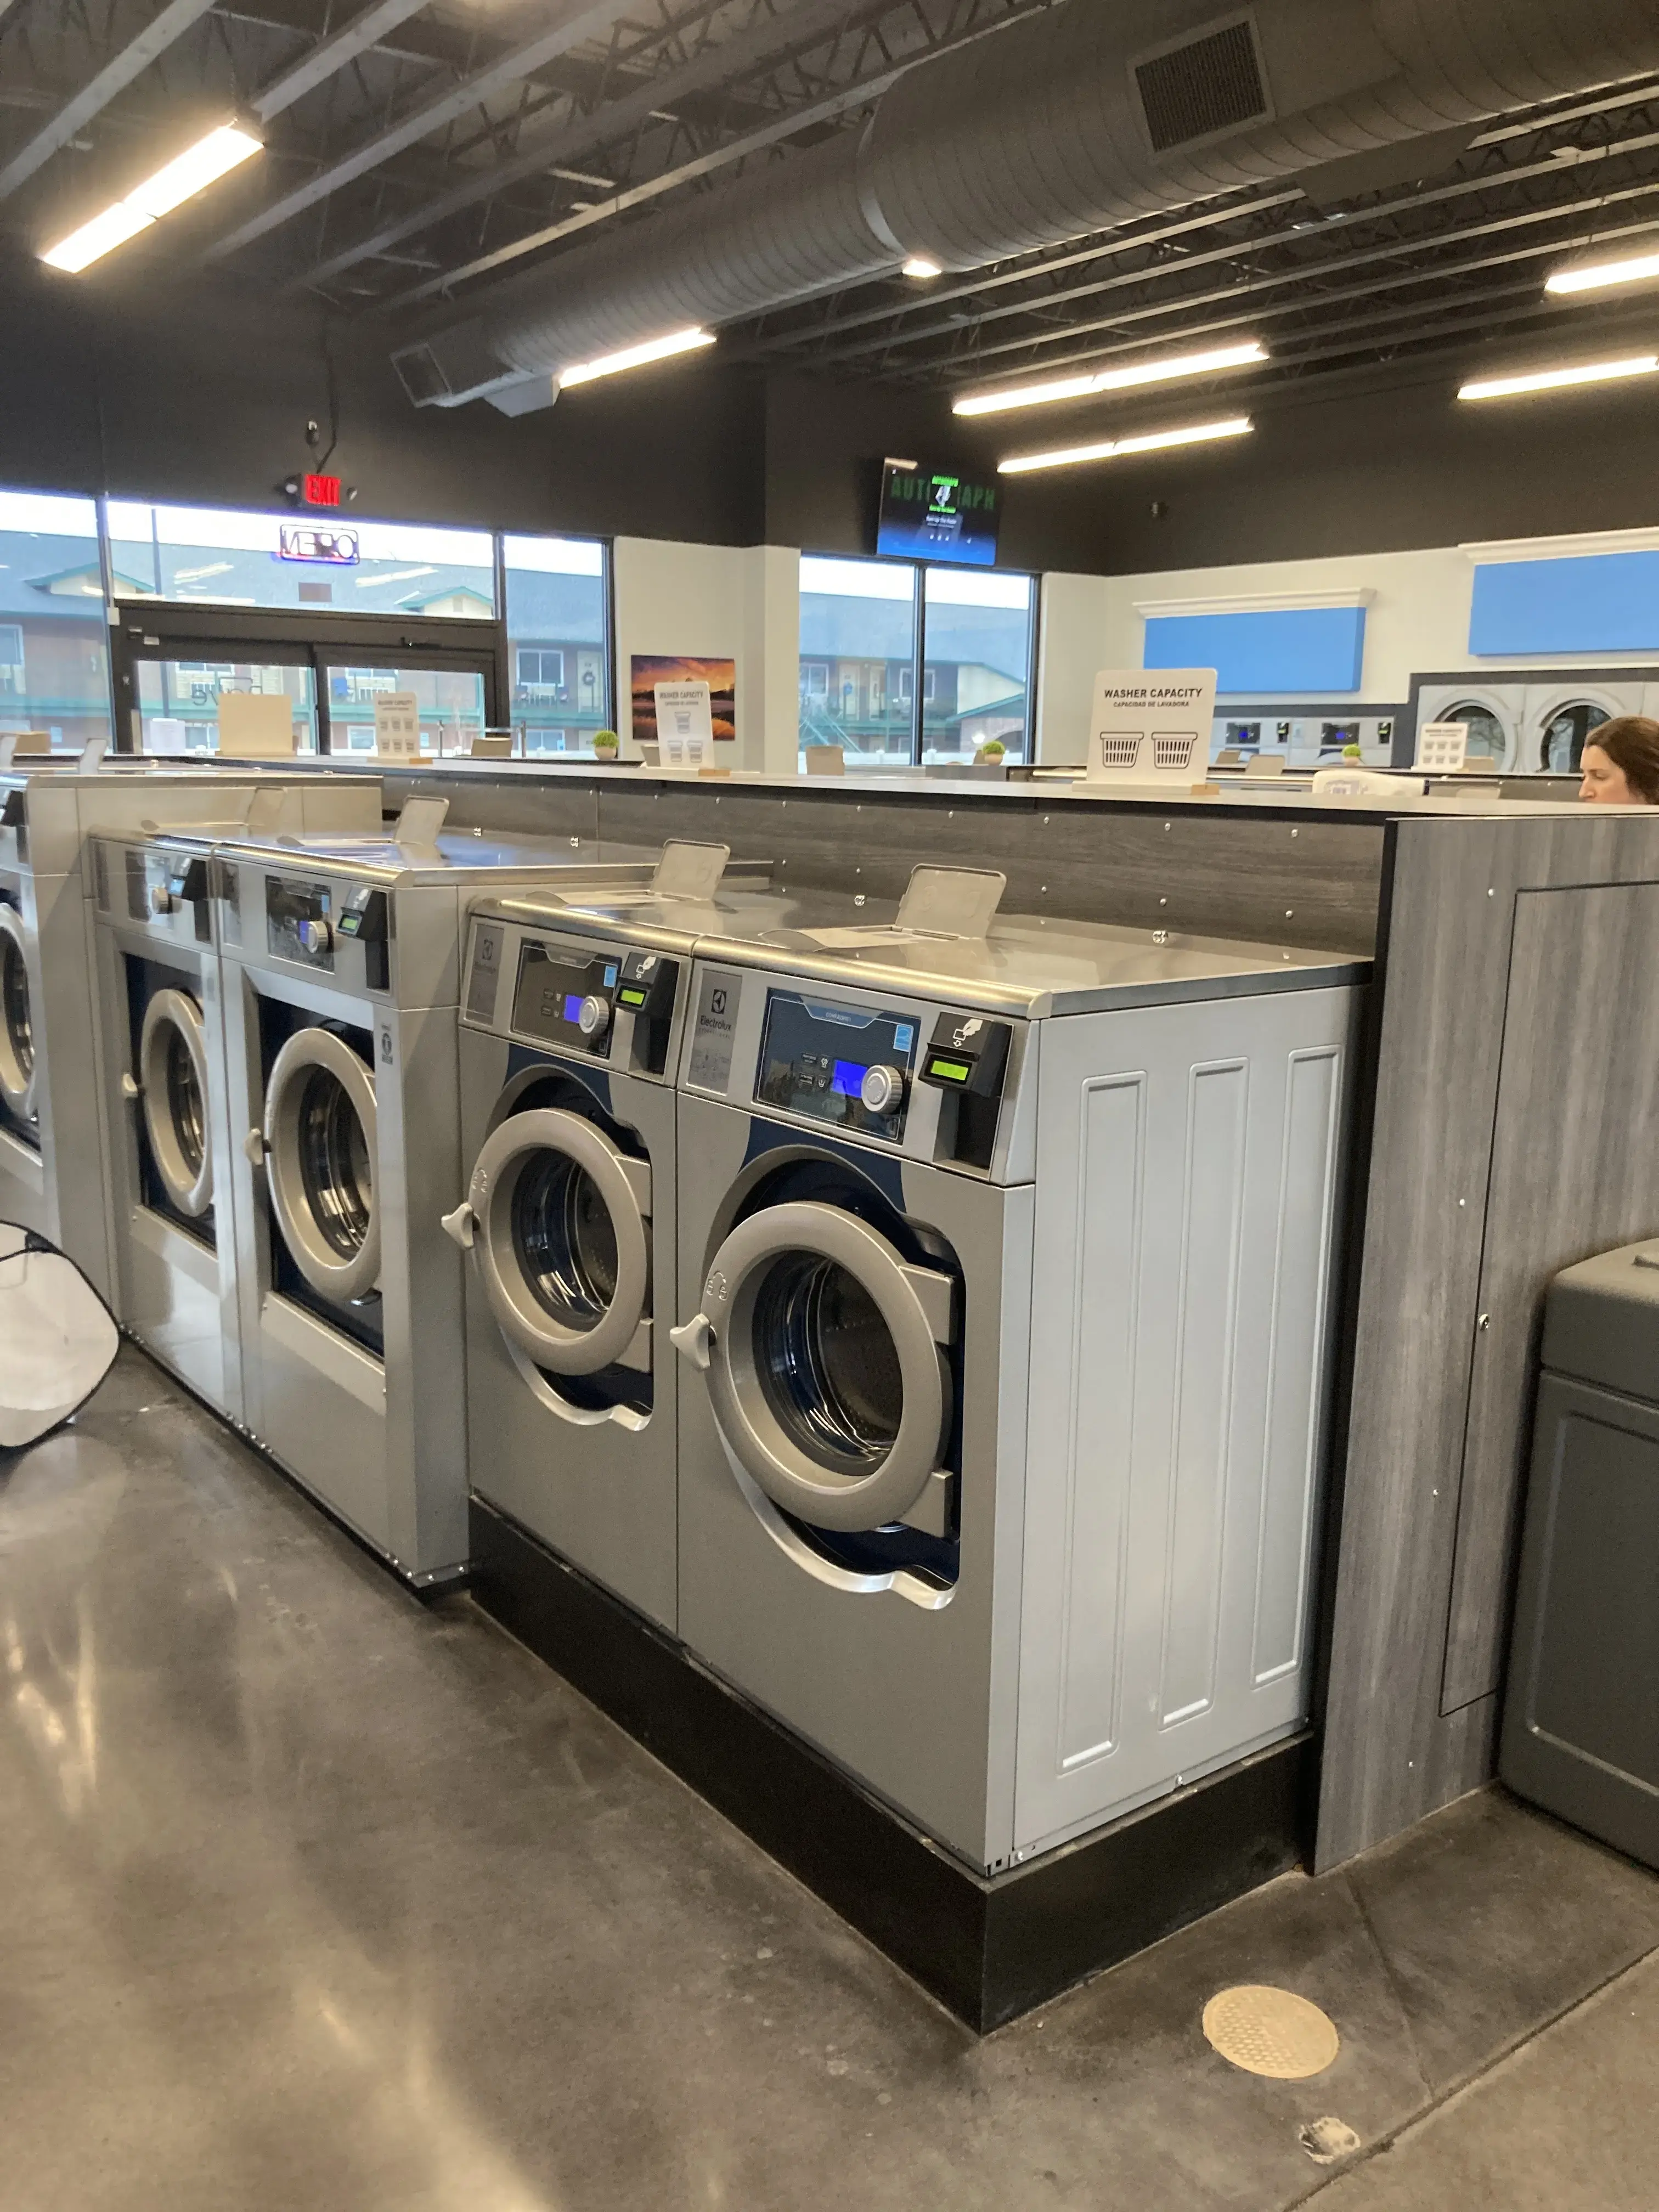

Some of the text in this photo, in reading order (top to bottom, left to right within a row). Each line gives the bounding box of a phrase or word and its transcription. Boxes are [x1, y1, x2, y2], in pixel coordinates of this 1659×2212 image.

[306, 475, 342, 506] EXIT
[1104, 687, 1203, 698] WASHER CAPACITY
[700, 1015, 731, 1032] Electrolux
